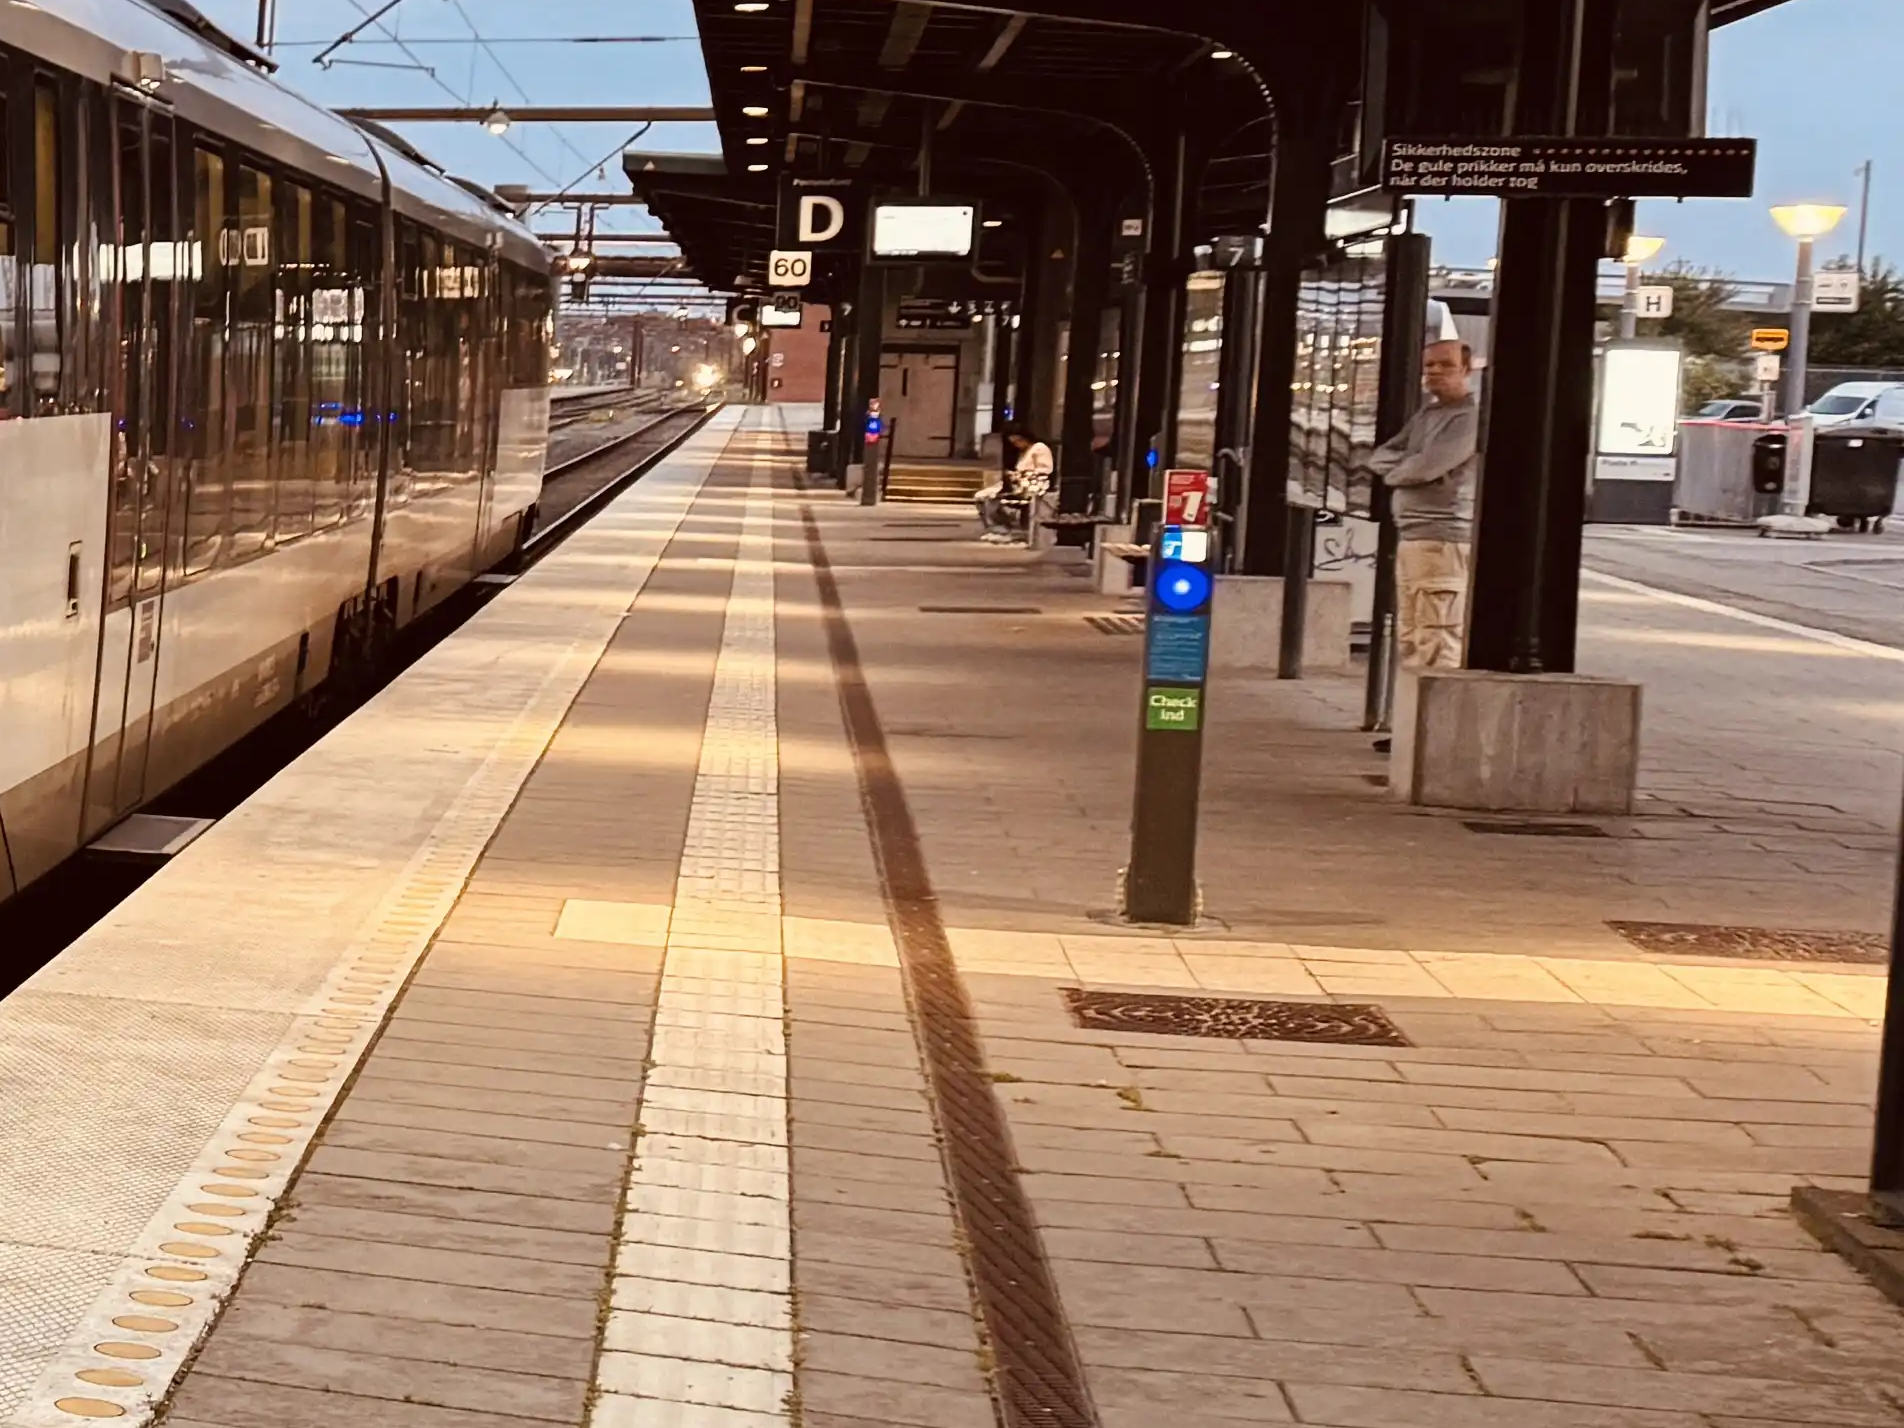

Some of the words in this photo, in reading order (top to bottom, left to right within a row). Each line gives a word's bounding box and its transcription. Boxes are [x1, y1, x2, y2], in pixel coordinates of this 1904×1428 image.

[1392, 143, 1522, 158] Sikkerhedszone
[1391, 159, 1415, 172] De
[1418, 160, 1454, 174] gule
[1457, 160, 1517, 174] prikker
[1519, 159, 1546, 173] må
[1549, 160, 1582, 173] kun
[1585, 160, 1688, 175] overskrides,
[1389, 174, 1418, 187] når
[1419, 174, 1449, 187] der
[1452, 174, 1507, 188] holder
[1508, 176, 1539, 190] tog
[799, 195, 845, 242] D
[1228, 247, 1245, 267] 7
[774, 258, 807, 277] 60
[1646, 295, 1662, 312] H
[1150, 694, 1197, 709] Check
[1160, 709, 1185, 722] ind
